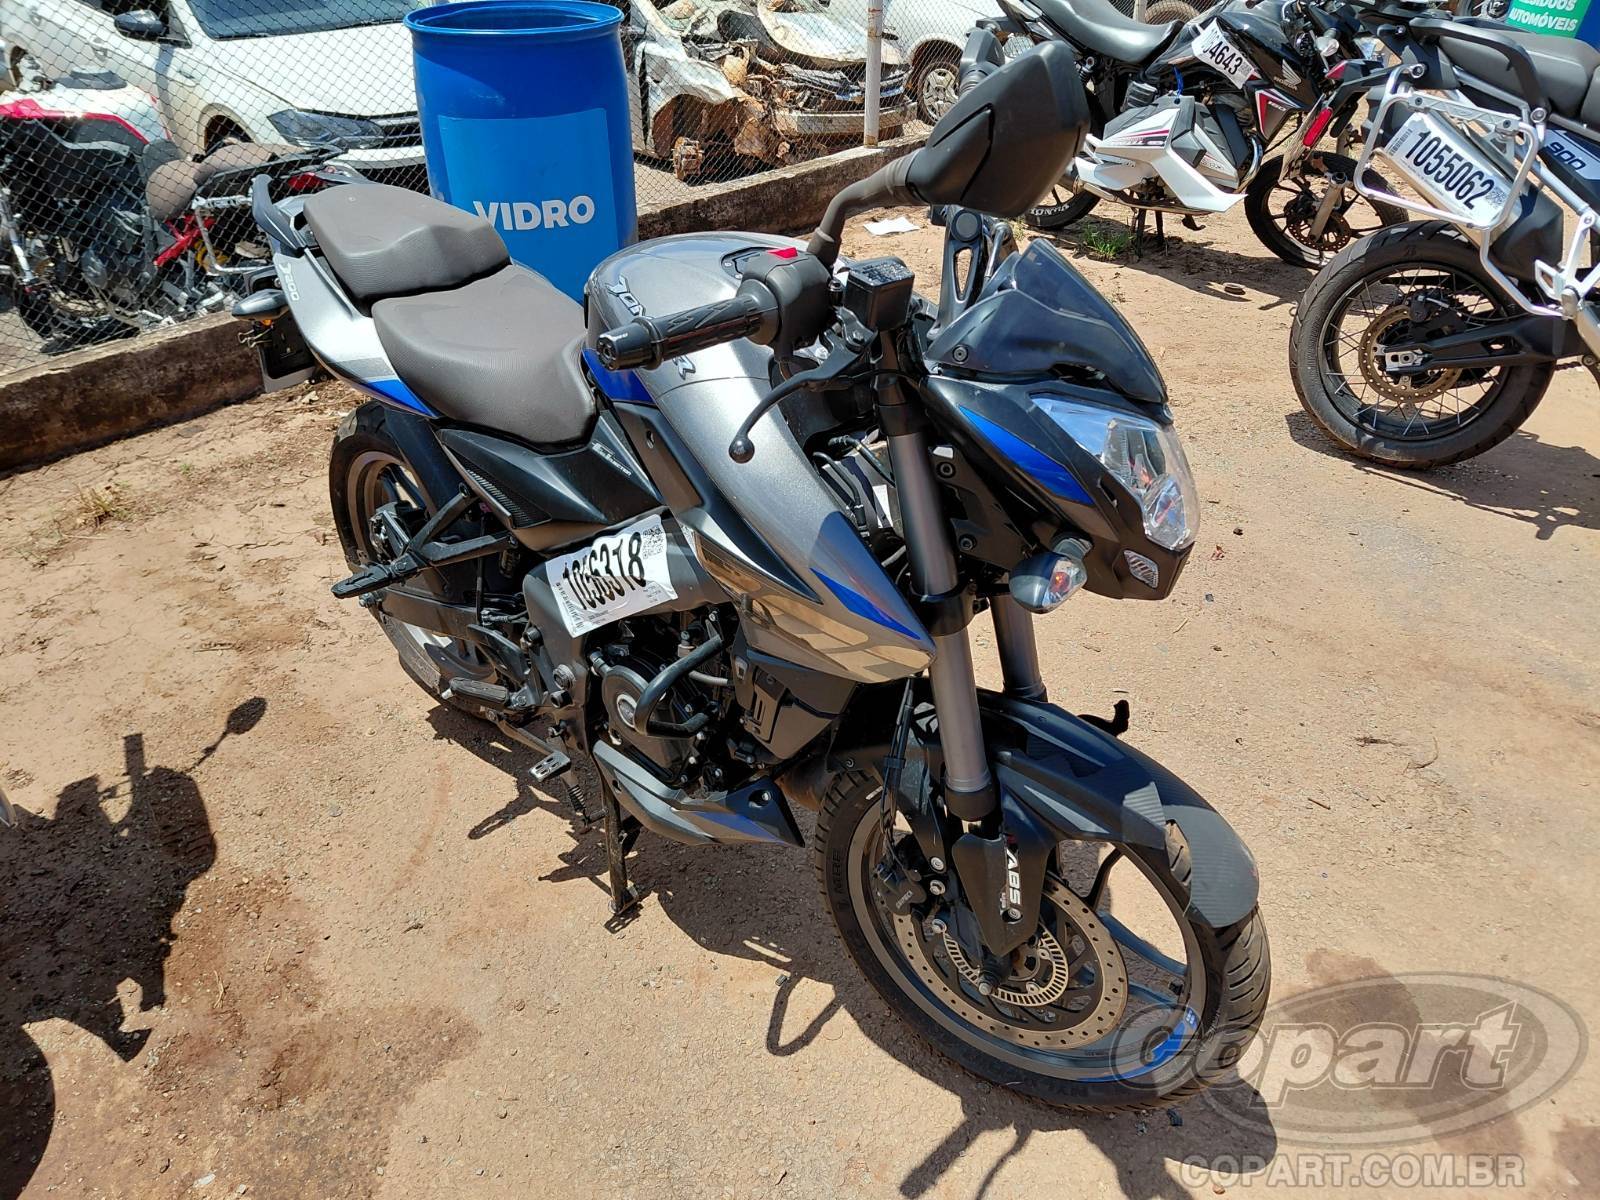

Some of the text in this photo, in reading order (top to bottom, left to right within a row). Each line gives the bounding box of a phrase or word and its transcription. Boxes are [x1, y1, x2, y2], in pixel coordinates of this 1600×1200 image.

[1509, 7, 1578, 32] AUTOMÓVEIS
[1404, 129, 1495, 210] 1055062
[1546, 141, 1587, 171] 900
[472, 195, 595, 231] VIDRO
[562, 531, 647, 611] 1056318
[1005, 848, 1021, 905] ABS
